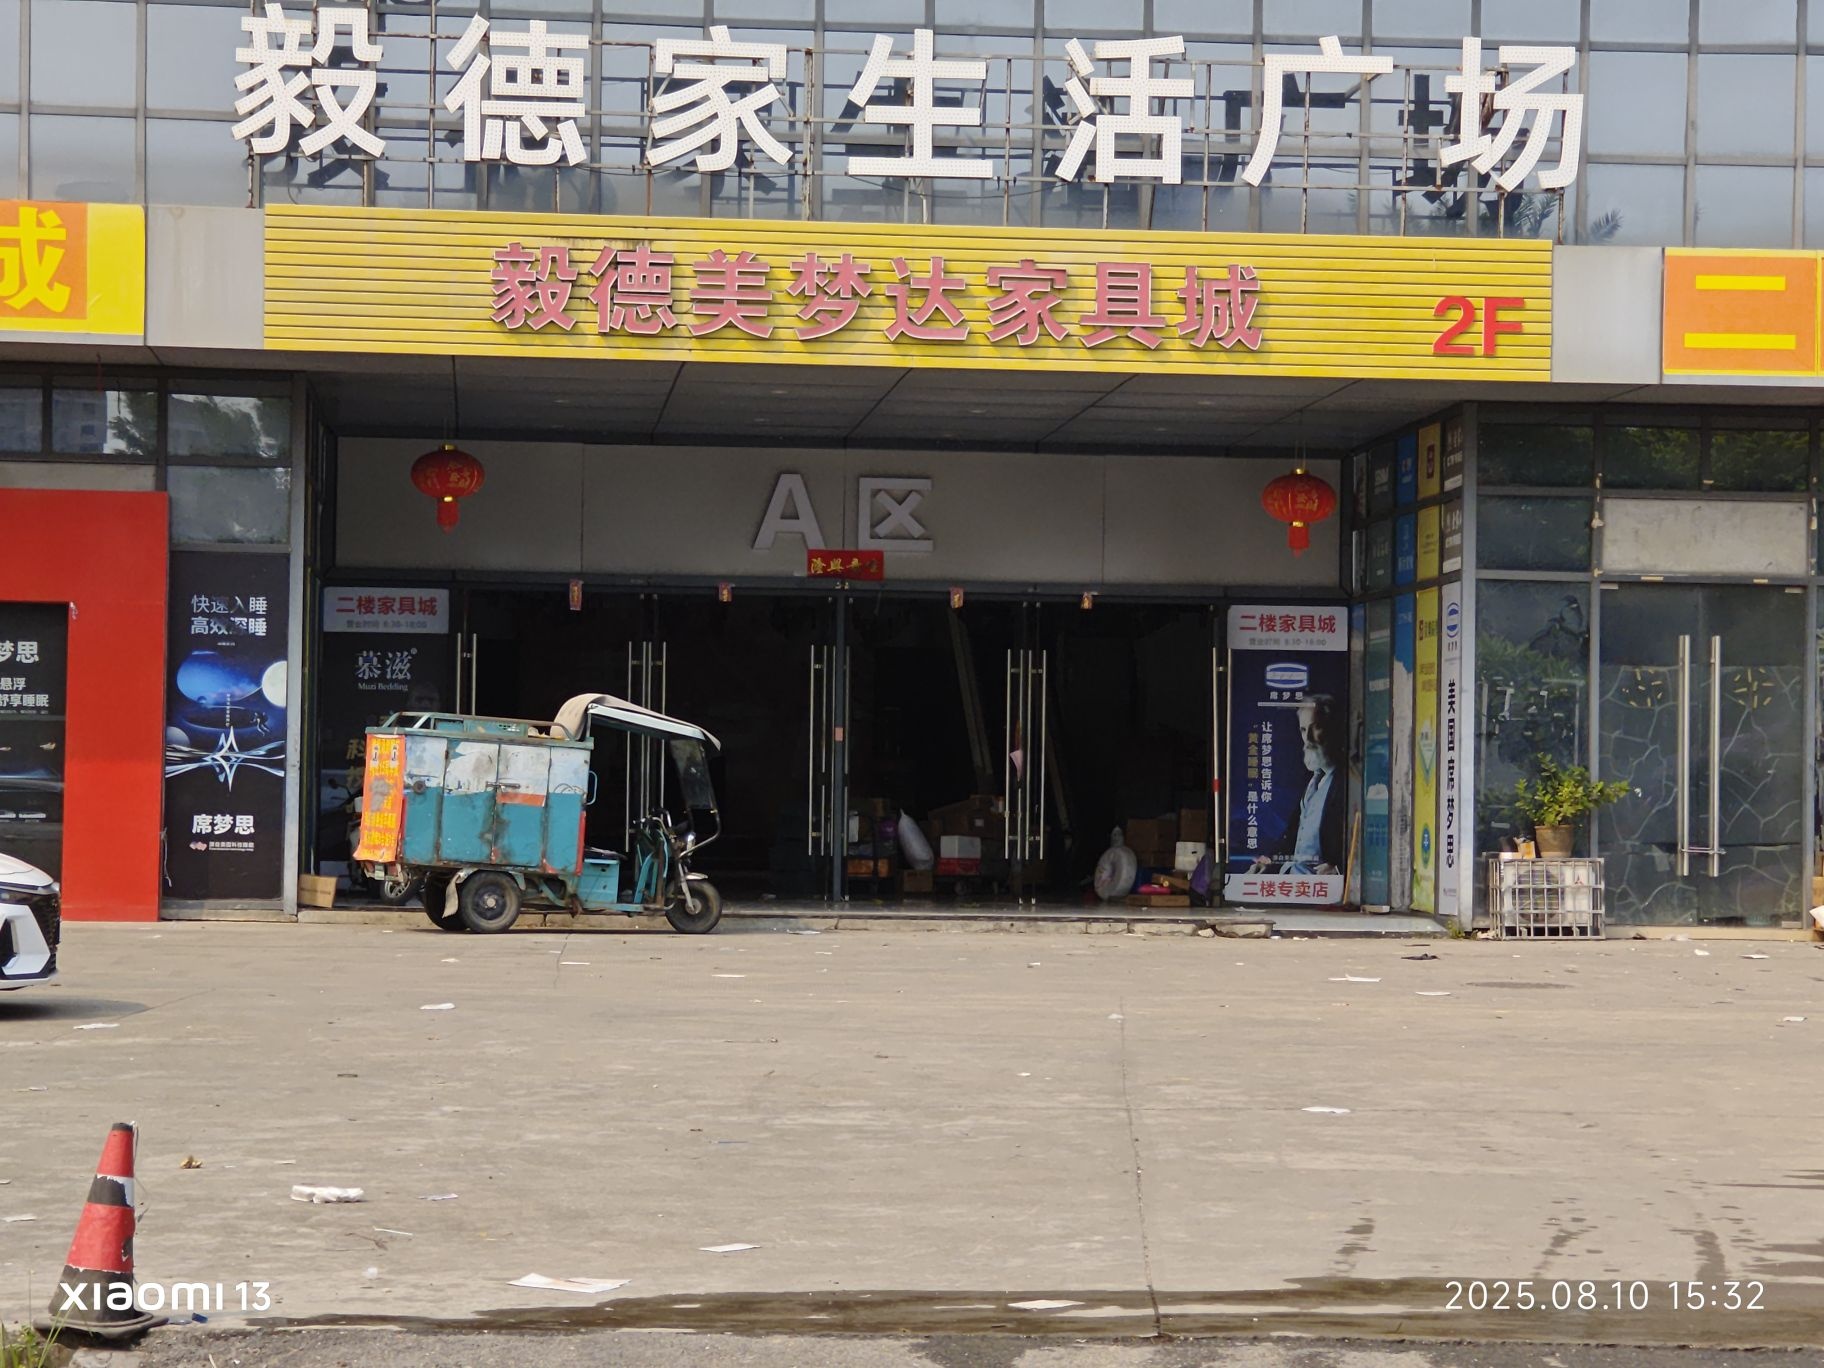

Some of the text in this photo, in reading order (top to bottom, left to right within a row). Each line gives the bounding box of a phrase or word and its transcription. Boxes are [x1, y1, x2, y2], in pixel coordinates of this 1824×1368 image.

[231, 2, 1584, 193] 毅德家生活广场
[490, 242, 1262, 351] 毅德美梦达家具城
[1683, 274, 1797, 350] 二
[1432, 295, 1526, 357] 2F
[191, 595, 268, 614] 快速入睡
[336, 595, 438, 616] 二楼家具城
[191, 617, 268, 636] 高效深睡
[1239, 614, 1336, 633] 二楼家具城
[1269, 691, 1304, 701] 席梦思
[1261, 721, 1273, 803] 让席梦思告诉你
[1446, 678, 1457, 869] 美国席梦思
[192, 813, 255, 835] 席梦思
[1242, 880, 1329, 899] 二楼专卖店
